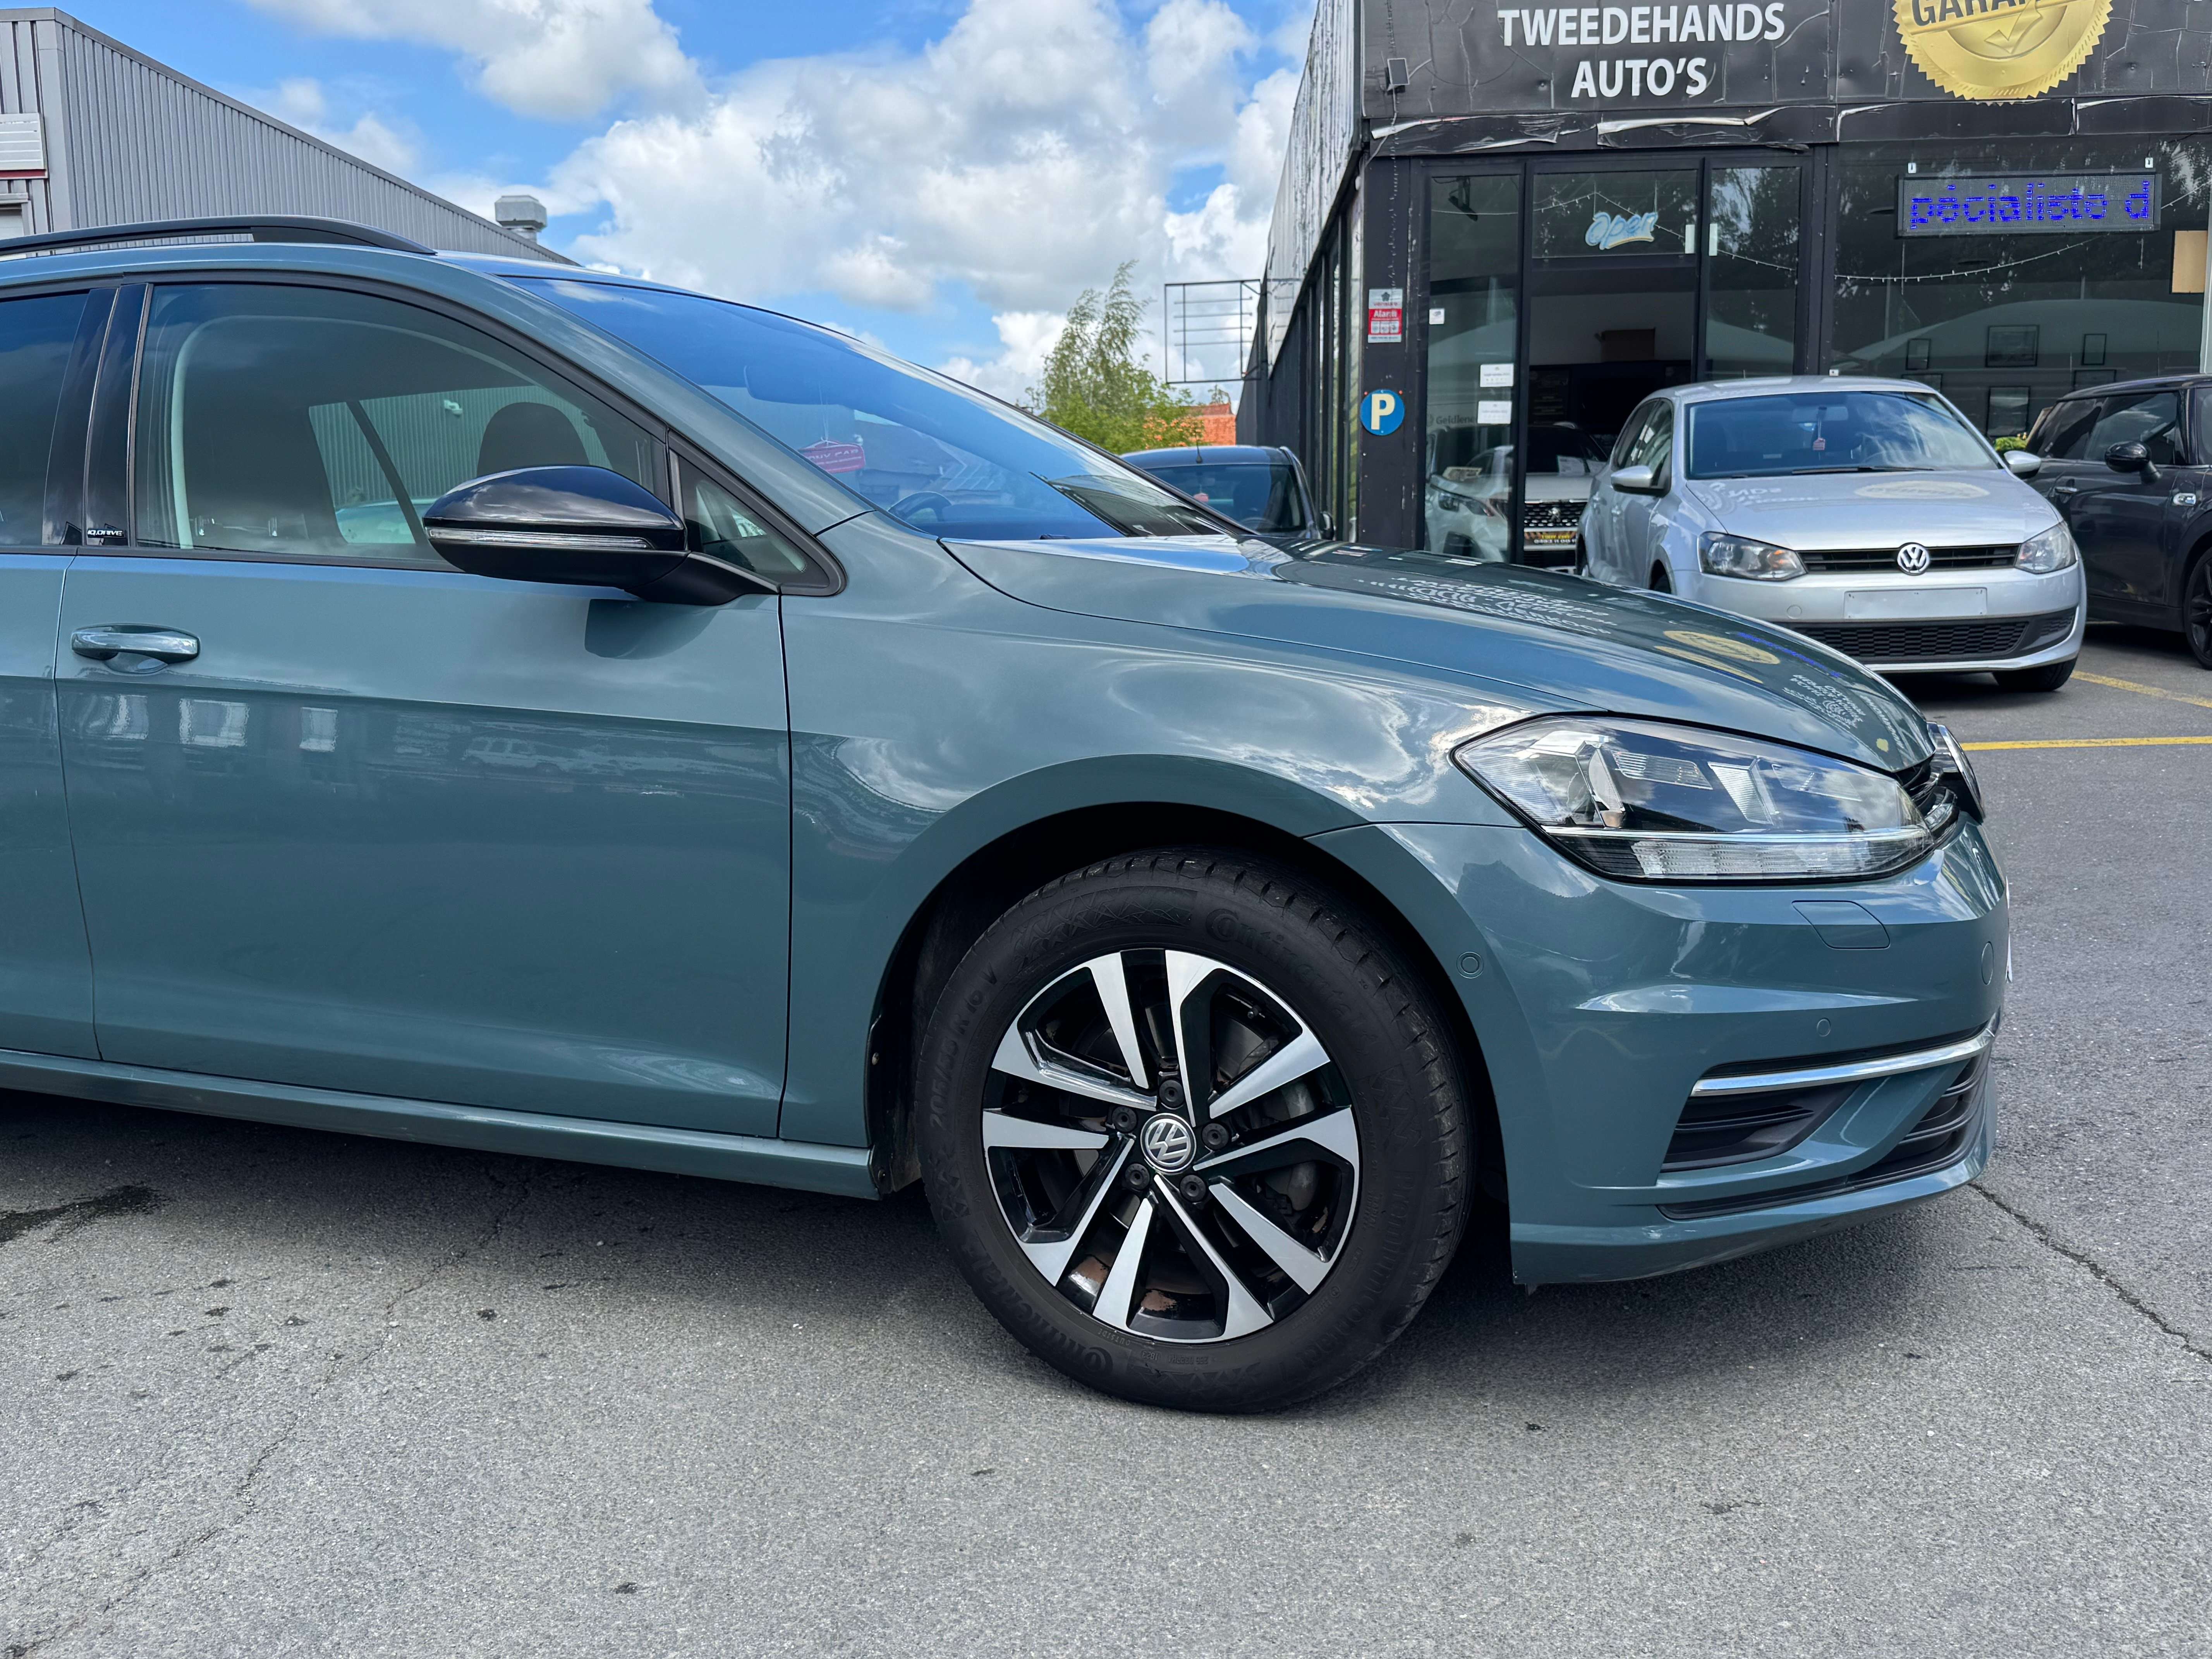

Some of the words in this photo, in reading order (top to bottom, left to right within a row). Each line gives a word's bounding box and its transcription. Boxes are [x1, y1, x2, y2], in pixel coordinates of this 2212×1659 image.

[1497, 3, 1785, 46] TWEEDEHANDS
[1571, 58, 1707, 98] AUTO'S
[1371, 393, 1395, 430] P
